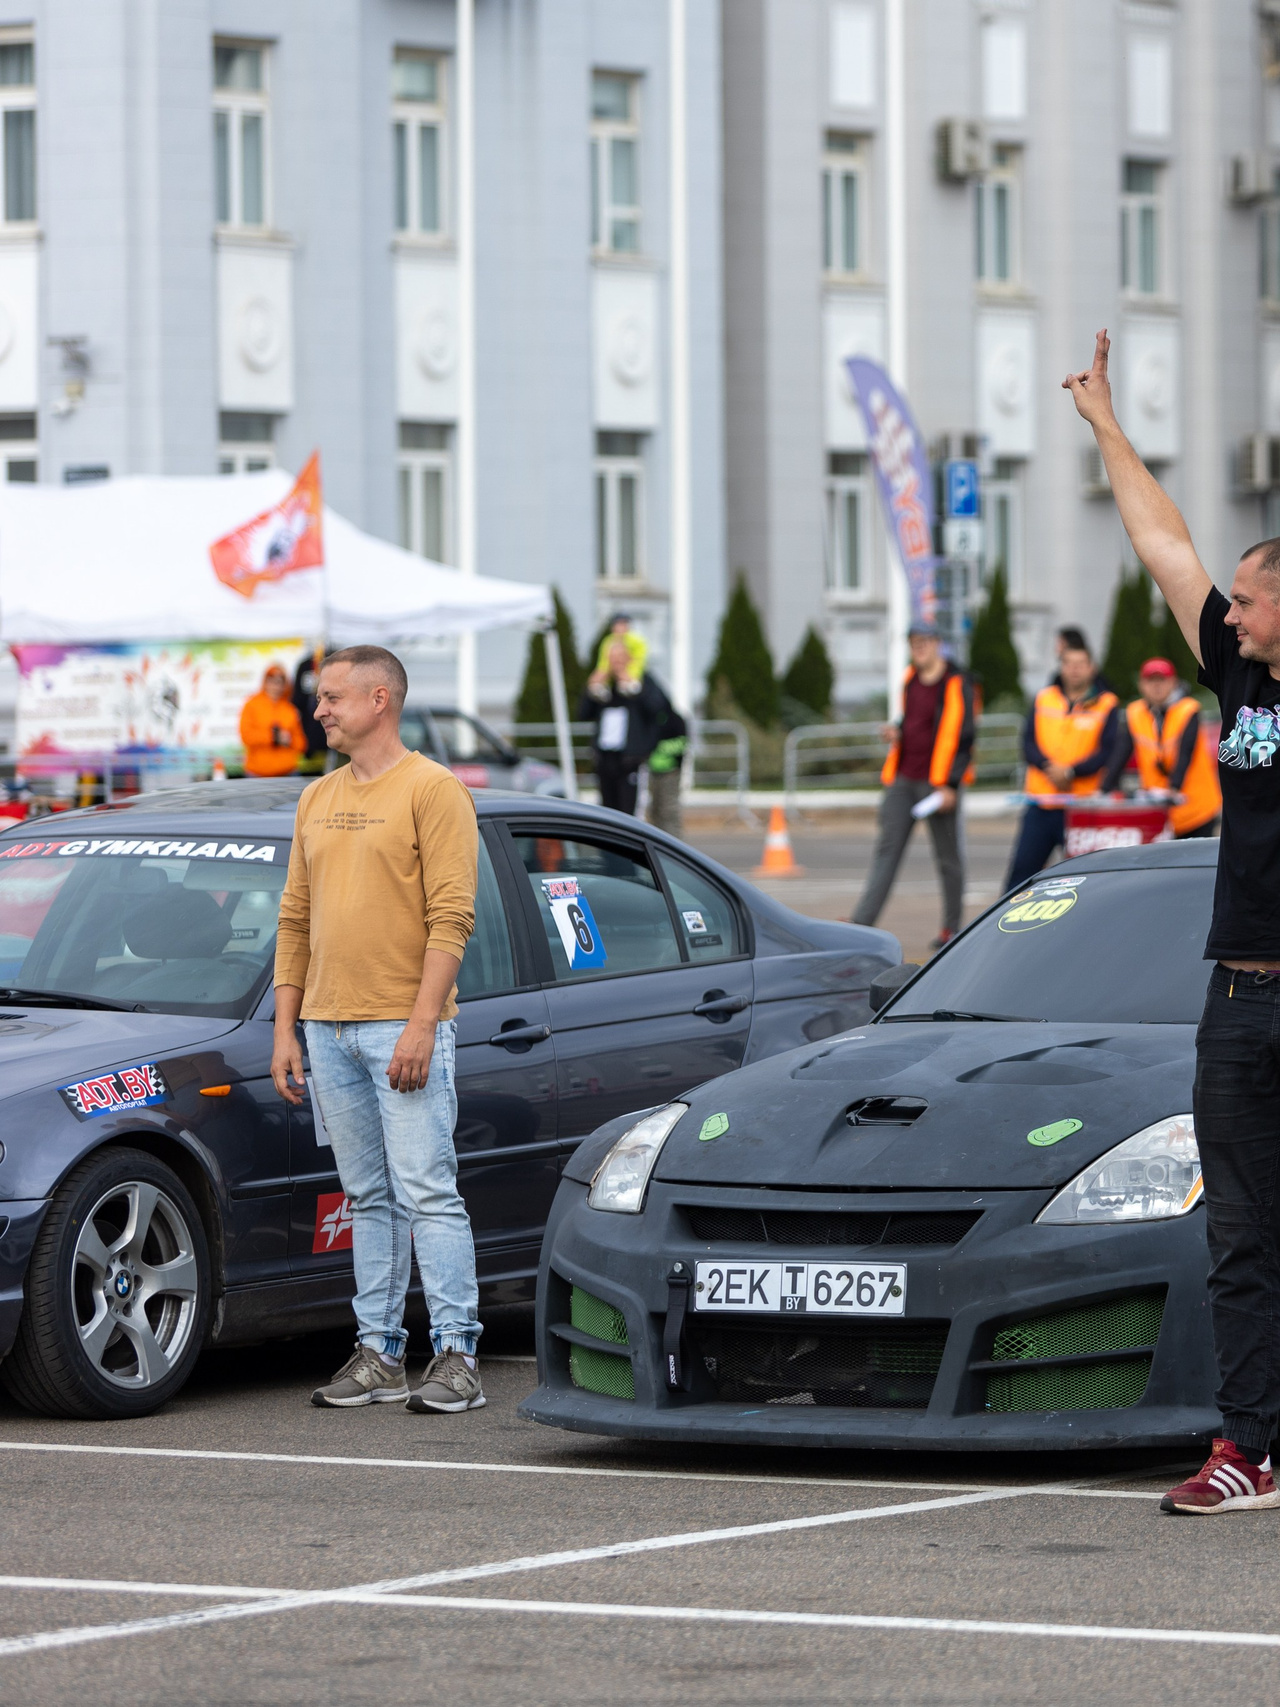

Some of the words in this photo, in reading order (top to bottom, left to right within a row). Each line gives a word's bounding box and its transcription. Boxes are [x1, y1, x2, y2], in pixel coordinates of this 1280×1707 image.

[567, 903, 595, 955] 6
[1003, 898, 1074, 923] 400
[76, 1064, 157, 1114] ADT.BY
[707, 1268, 771, 1305] 2EK
[785, 1266, 805, 1295] T
[814, 1269, 899, 1308] 6267
[786, 1297, 800, 1310] BY
